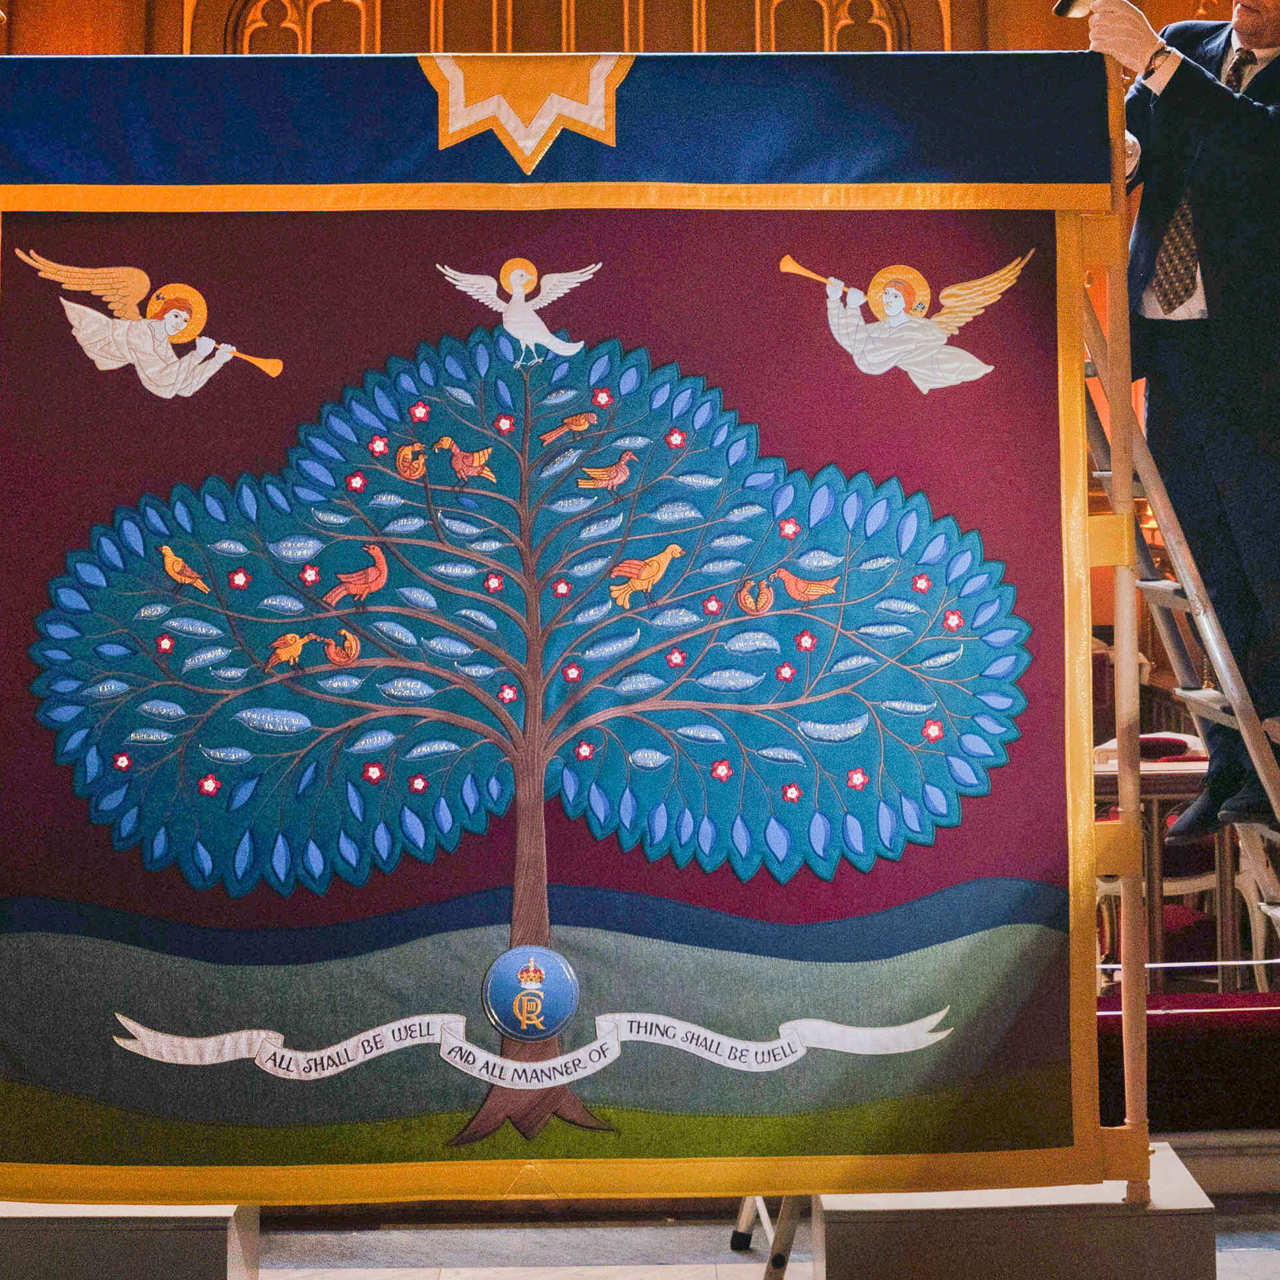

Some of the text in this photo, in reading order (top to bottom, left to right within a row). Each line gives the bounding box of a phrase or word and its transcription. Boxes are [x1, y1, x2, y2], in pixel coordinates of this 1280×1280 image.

[266, 1021, 435, 1074] ALL SHALL BE WELL
[447, 1042, 610, 1084] AND ALL MANNER OF
[627, 1019, 798, 1066] THING SHALL BE WELL
